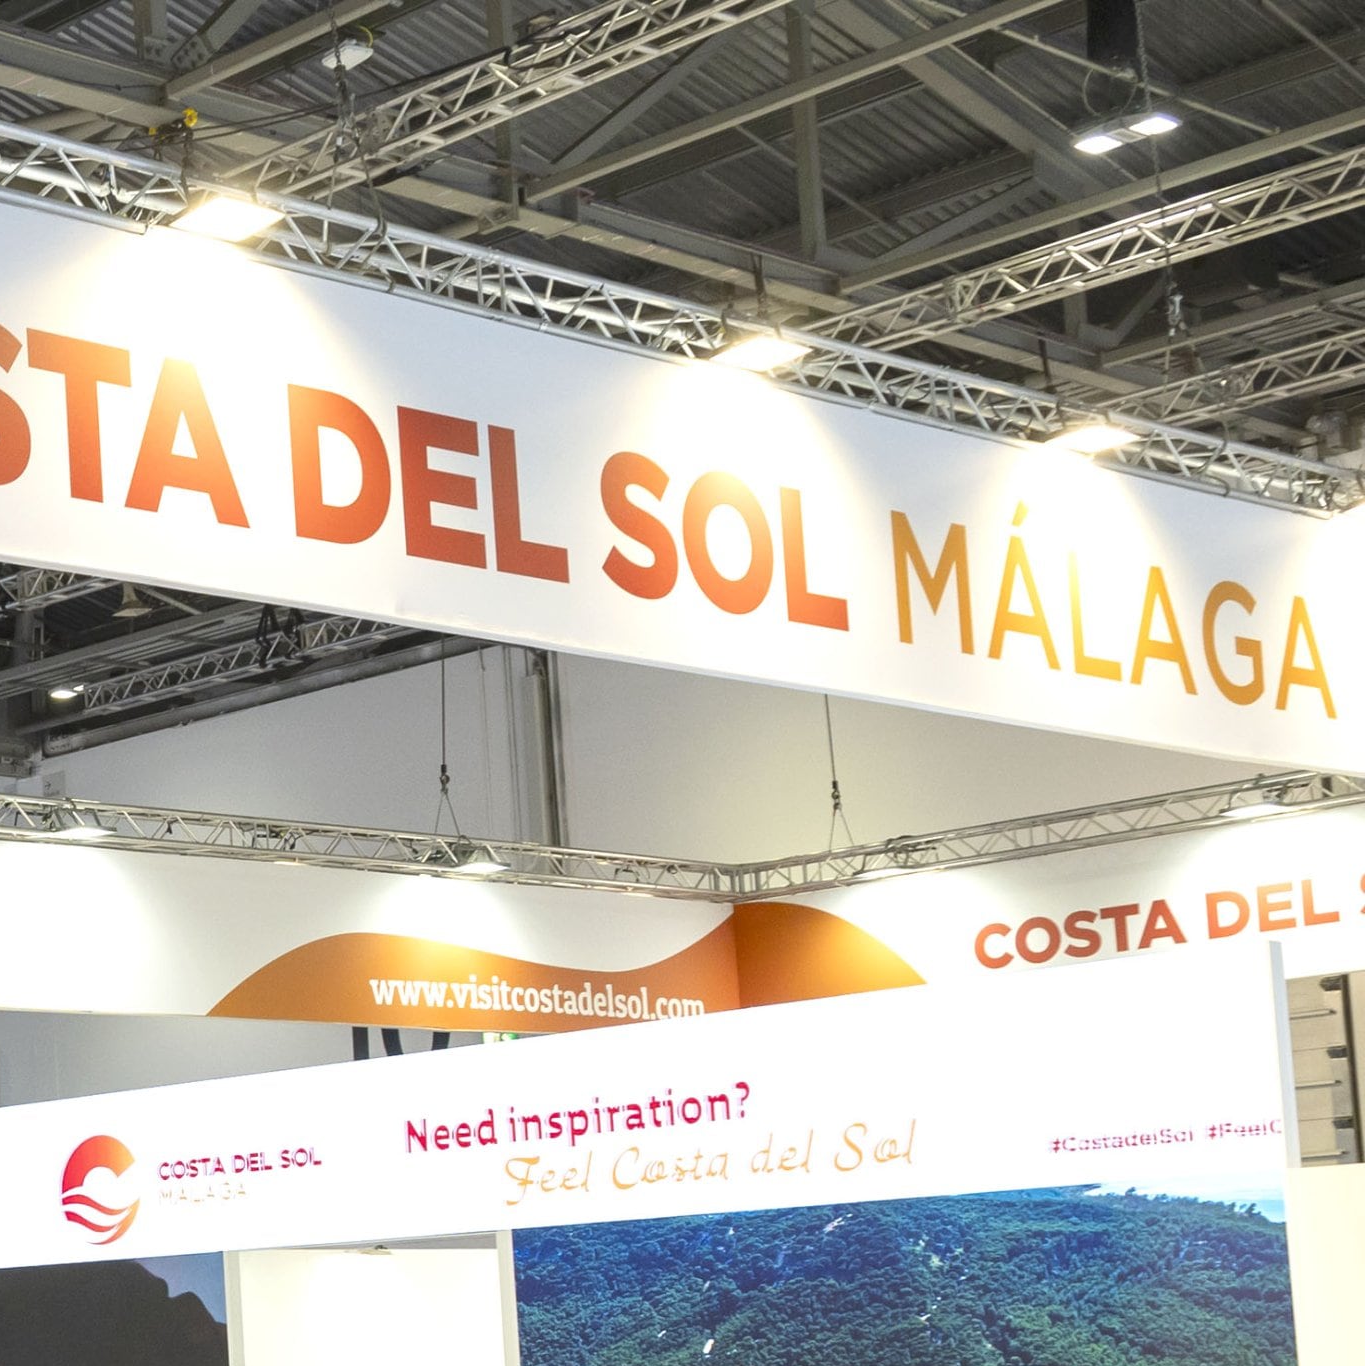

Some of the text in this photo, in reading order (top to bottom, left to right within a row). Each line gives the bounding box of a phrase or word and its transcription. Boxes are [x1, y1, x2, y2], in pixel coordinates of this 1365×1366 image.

[286, 383, 570, 584] DEL
[600, 449, 850, 632] SOL
[890, 500, 1338, 720] MÁLAGA
[974, 879, 1340, 969] COSTA DEL
[370, 974, 705, 1021] www.visitcostadelsol.com
[404, 1081, 750, 1153] Need inspiration?
[158, 1147, 322, 1181] COSTA DEL SOL
[504, 1119, 916, 1206] Feel Costa del Sol
